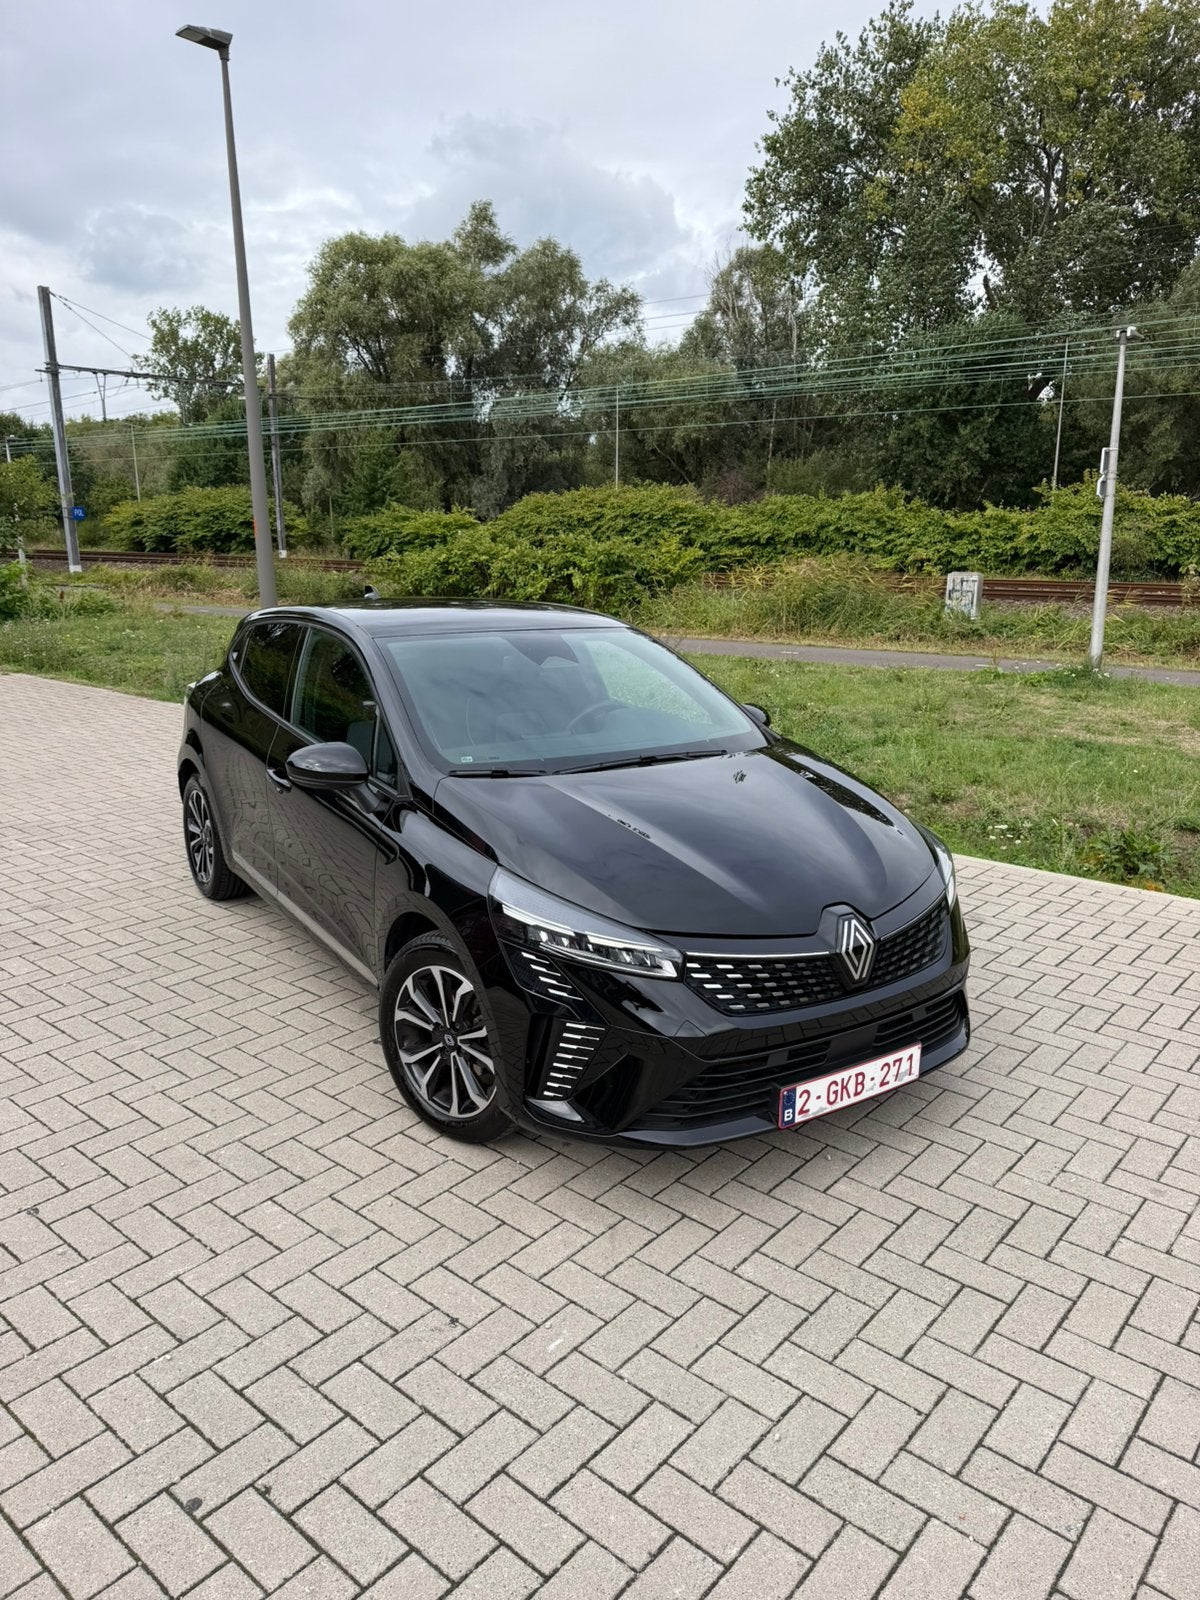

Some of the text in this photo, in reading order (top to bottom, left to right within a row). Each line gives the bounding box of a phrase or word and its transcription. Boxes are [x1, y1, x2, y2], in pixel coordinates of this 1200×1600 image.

[74, 509, 85, 517] POL
[797, 1053, 914, 1116] 2-GKB-271
[784, 1108, 793, 1122] B
